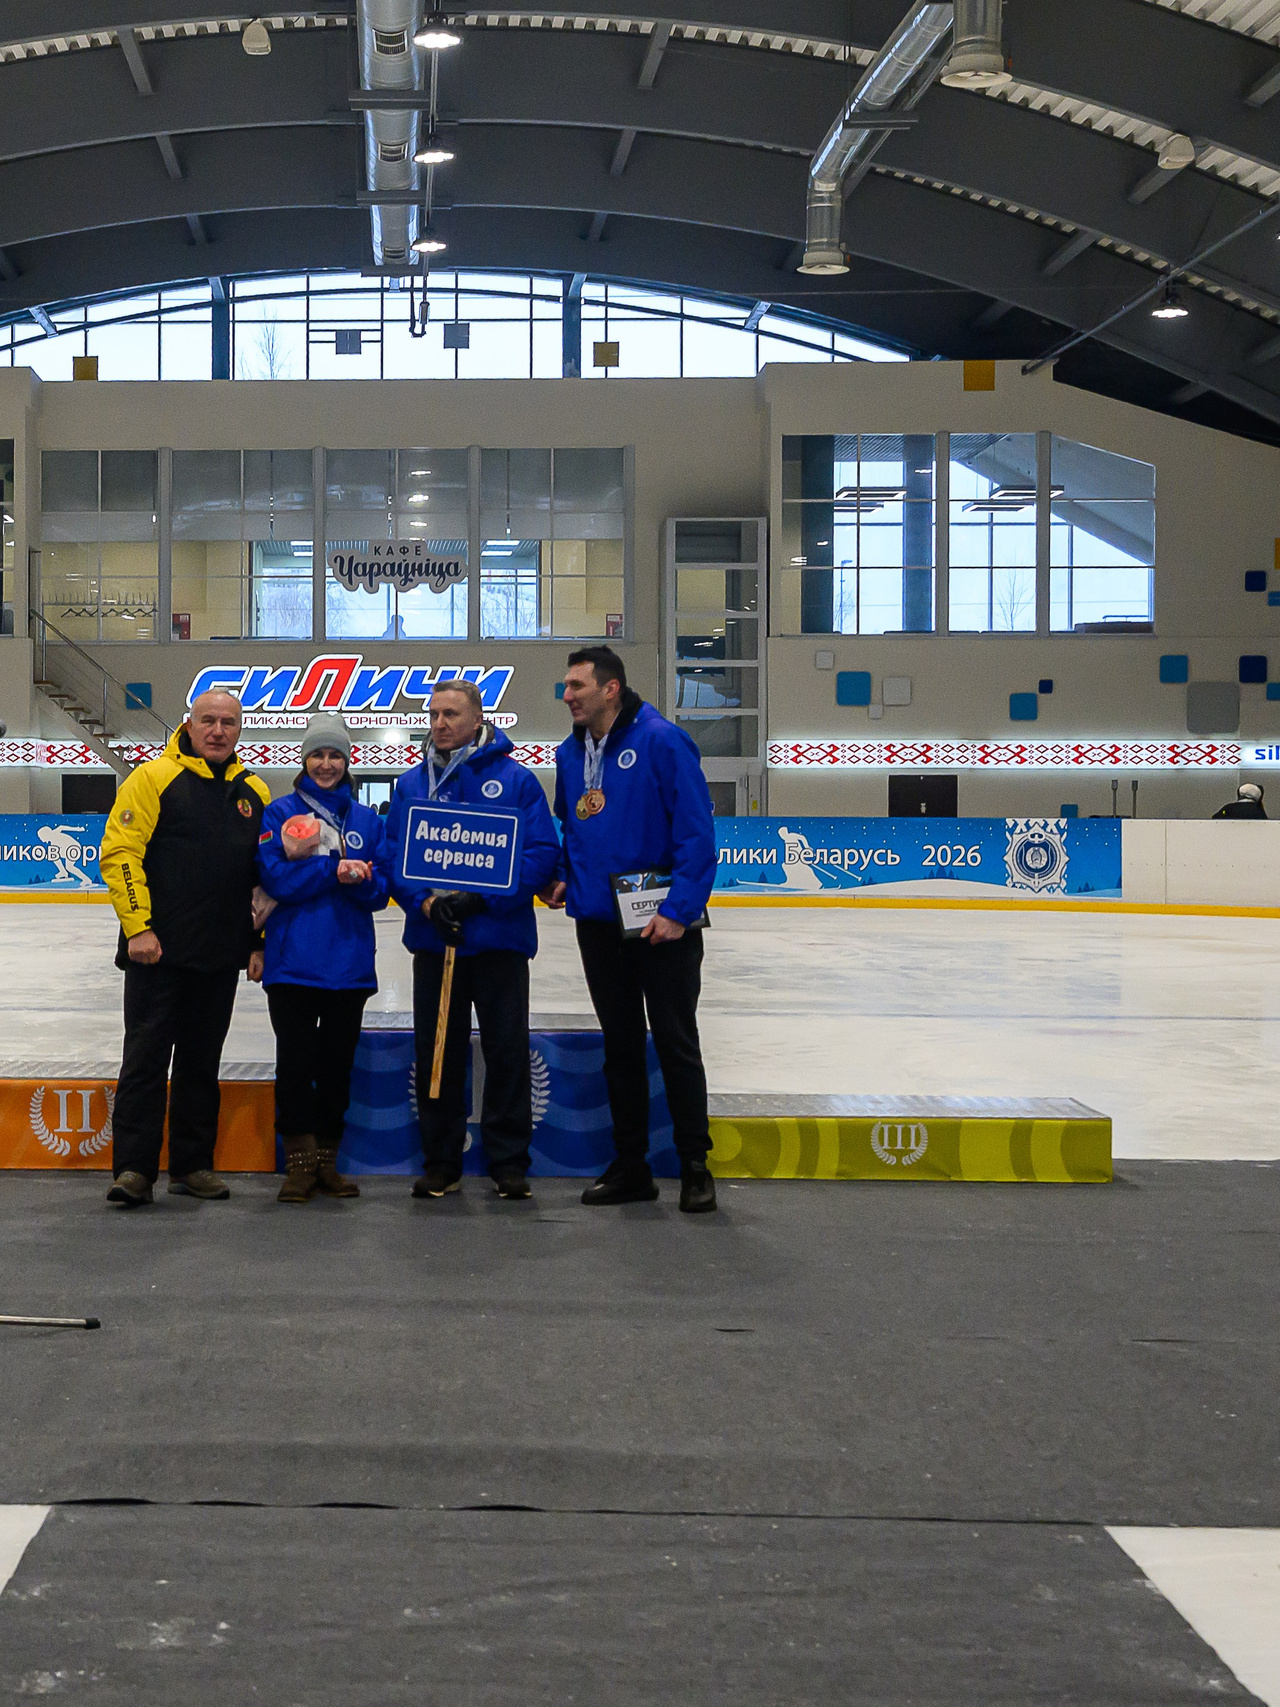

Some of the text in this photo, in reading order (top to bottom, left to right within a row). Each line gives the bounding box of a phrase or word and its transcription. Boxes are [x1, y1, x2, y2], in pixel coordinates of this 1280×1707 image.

[373, 545, 422, 556] КАФЕ
[333, 555, 462, 588] Чараўніца
[344, 716, 428, 725] ОРНОЛЫЖ
[415, 820, 508, 848] Академия
[66, 845, 102, 867] ор
[784, 842, 900, 870] Беларусь
[922, 844, 982, 867] 2026
[424, 848, 495, 870] сервиса
[121, 863, 139, 912] BELARUS
